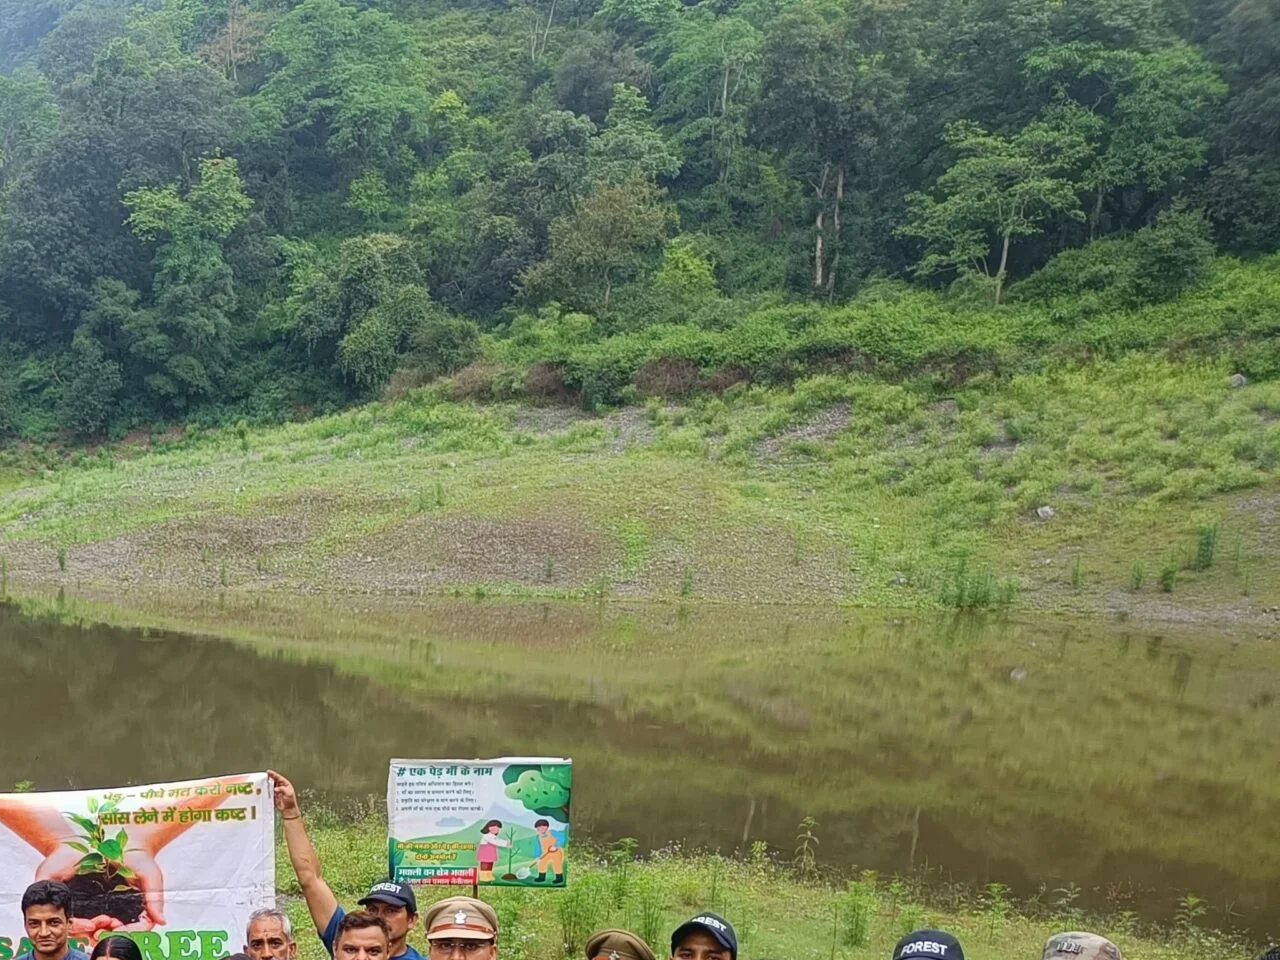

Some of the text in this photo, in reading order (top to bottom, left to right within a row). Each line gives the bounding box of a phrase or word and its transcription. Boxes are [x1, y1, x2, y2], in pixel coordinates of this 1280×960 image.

[397, 767, 406, 776] #
[409, 767, 426, 776] एक
[430, 765, 443, 778] पेड़
[461, 766, 471, 776] के
[473, 767, 493, 776] नाम
[168, 788, 191, 798] मत
[195, 782, 220, 796] करो
[133, 806, 159, 824] लेने
[161, 806, 177, 822] में
[178, 807, 212, 823] होगा
[215, 808, 247, 821] कष्ट
[399, 868, 421, 876] भवाली
[423, 868, 435, 876] वन
[451, 868, 474, 876] भवाली
[900, 941, 948, 957] FOREST
